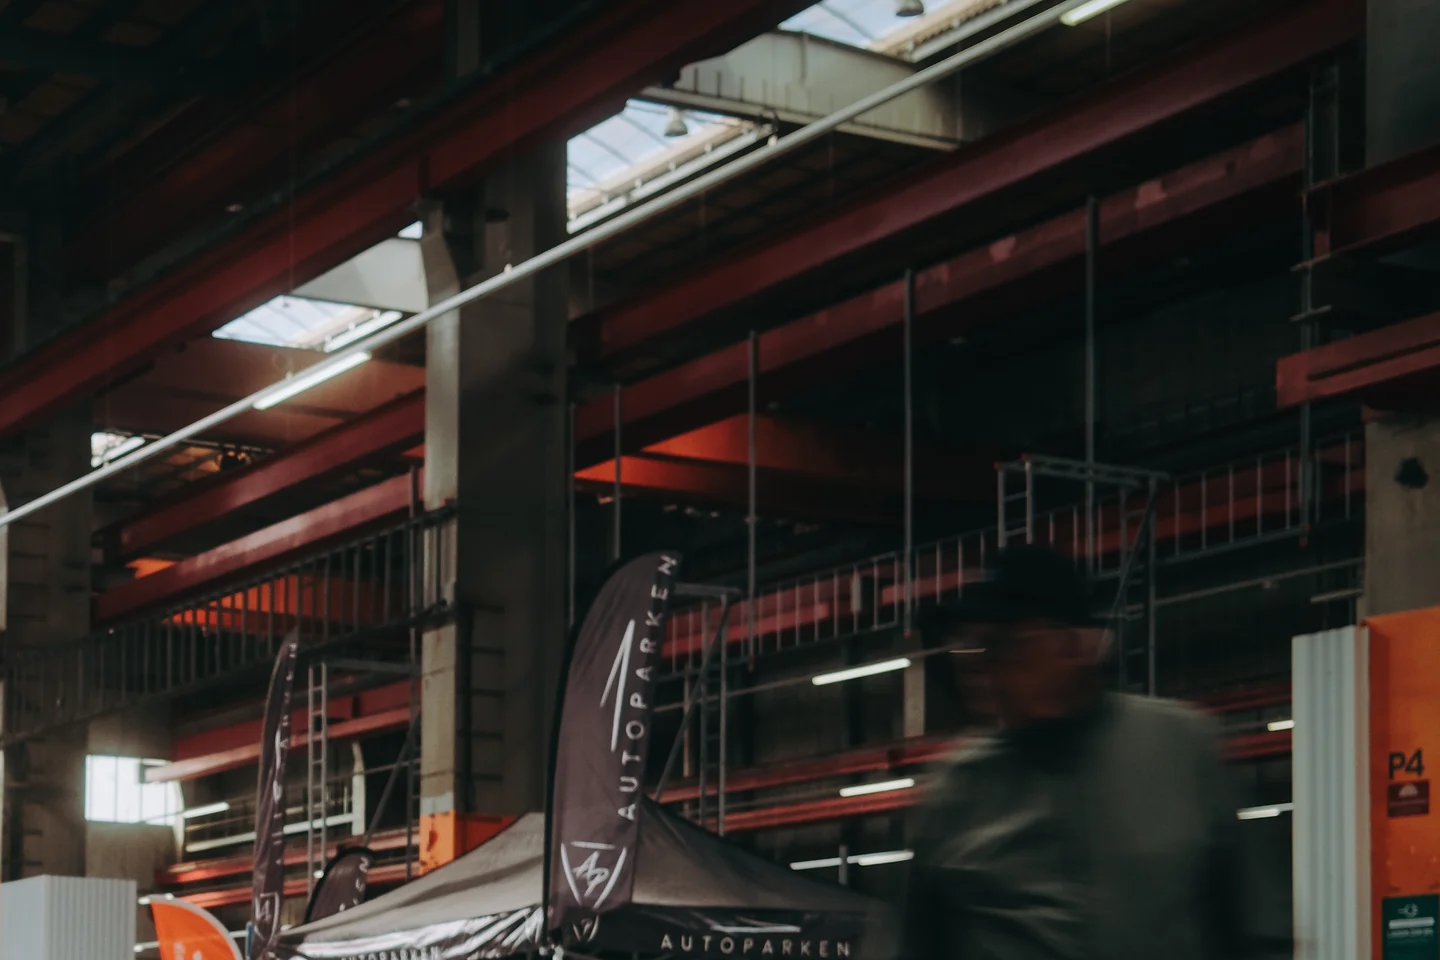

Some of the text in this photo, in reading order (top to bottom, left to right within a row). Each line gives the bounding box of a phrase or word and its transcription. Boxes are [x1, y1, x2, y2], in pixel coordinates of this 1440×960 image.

[617, 554, 679, 821] AUTOPARKEN
[1388, 748, 1425, 780] P4
[660, 933, 851, 958] AUTOPARKEN
